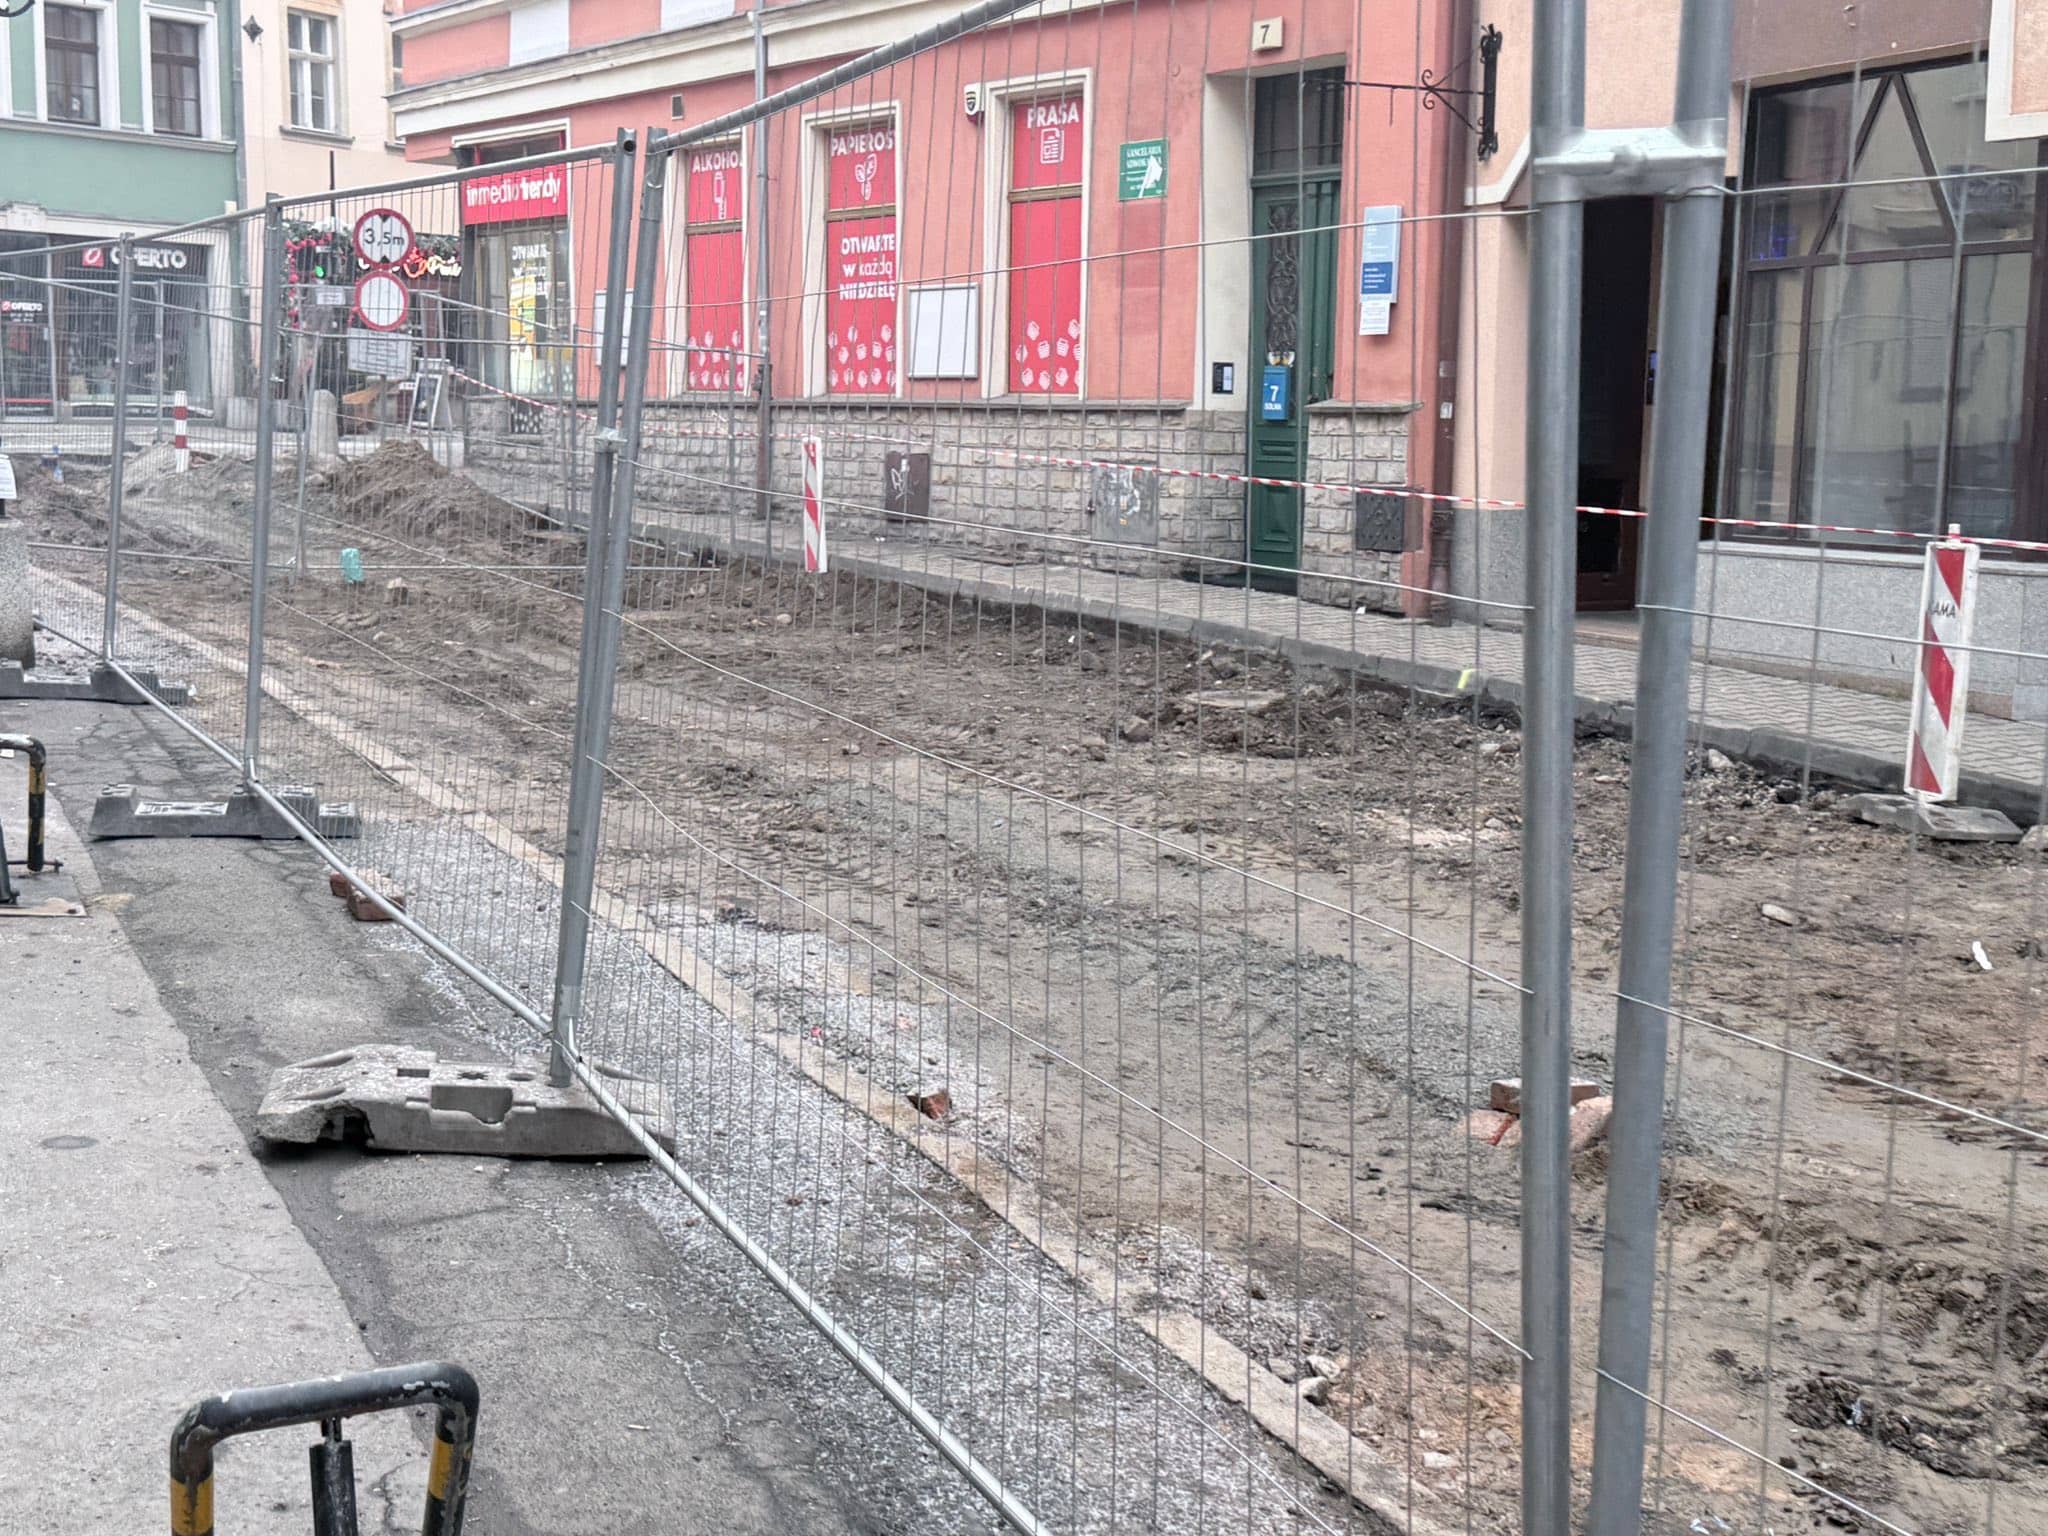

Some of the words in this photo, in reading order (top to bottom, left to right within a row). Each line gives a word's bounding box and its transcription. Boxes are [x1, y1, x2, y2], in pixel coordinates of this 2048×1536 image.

[1260, 24, 1270, 45] 7
[1027, 102, 1080, 129] PRASA
[831, 127, 896, 157] PAPIEROS
[692, 150, 743, 174] ALKOHO
[364, 227, 405, 247] 3,5m
[841, 233, 895, 256] OTWARTE
[110, 246, 187, 270] OERTO
[1269, 385, 1280, 402] 7
